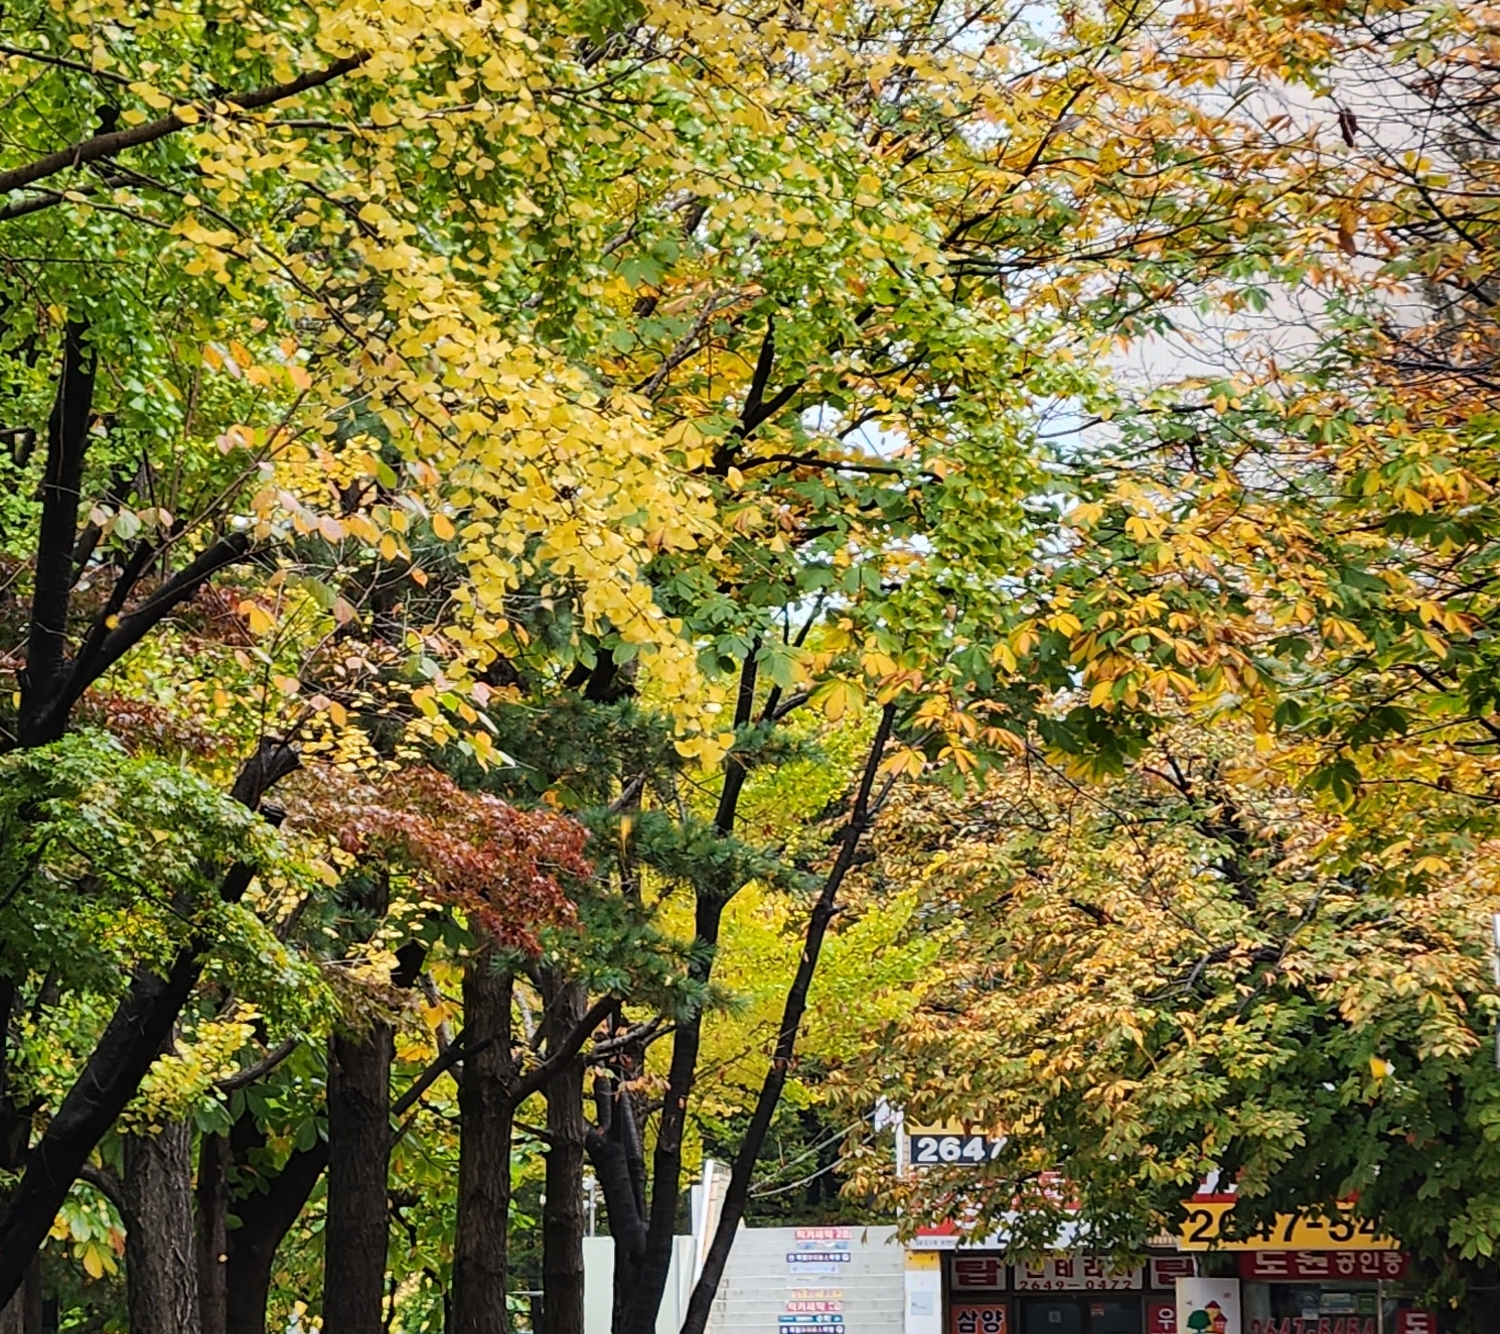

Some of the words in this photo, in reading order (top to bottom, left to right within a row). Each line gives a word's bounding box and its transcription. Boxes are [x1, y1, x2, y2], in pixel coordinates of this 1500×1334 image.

[917, 1137, 1008, 1162] 2647
[1254, 1251, 1329, 1275] 도원
[957, 1309, 1005, 1334] 삼양
